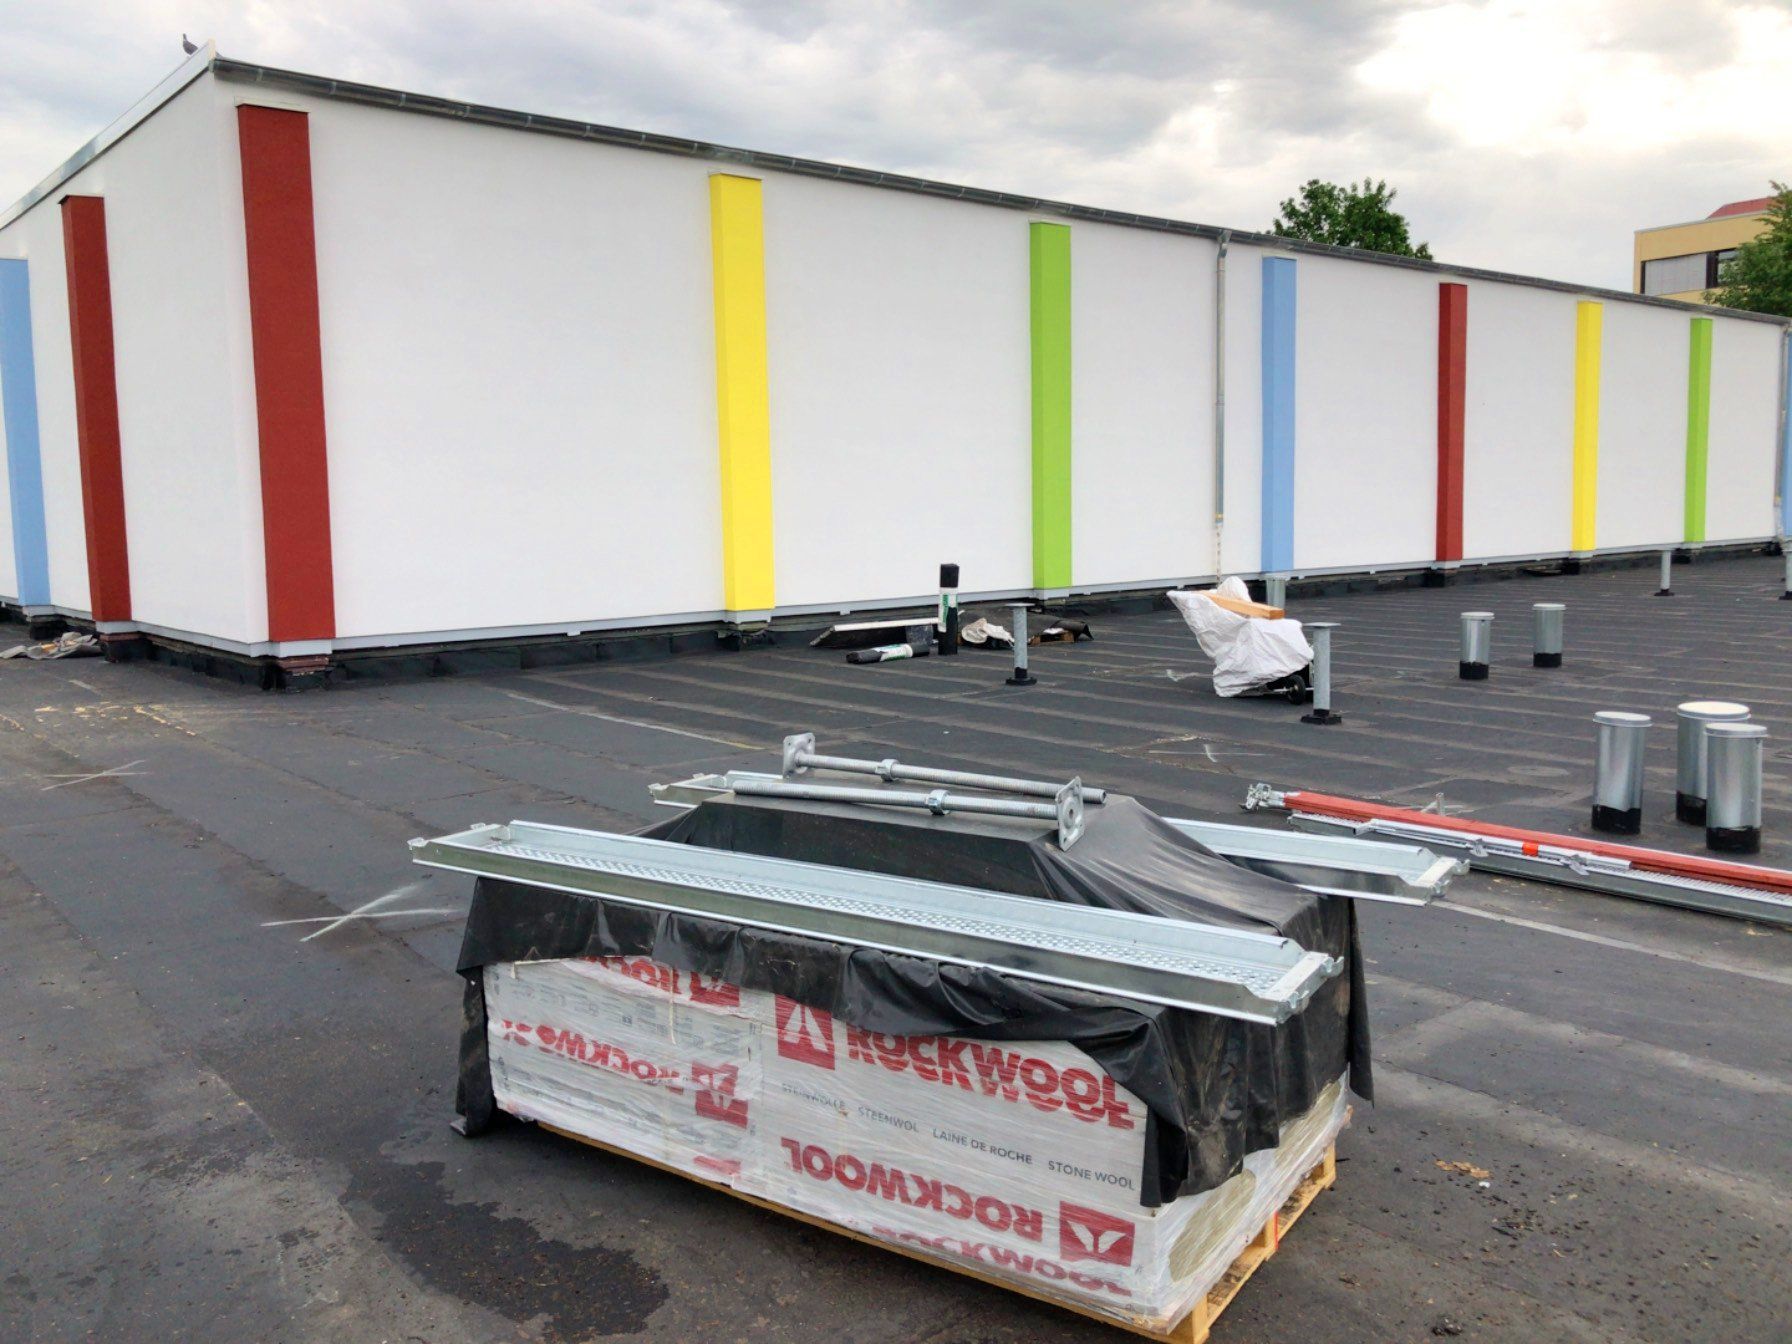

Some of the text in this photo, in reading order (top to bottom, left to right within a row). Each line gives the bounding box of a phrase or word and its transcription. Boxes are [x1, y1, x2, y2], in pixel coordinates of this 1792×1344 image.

[847, 1025, 1129, 1113] ROCKWOOL
[781, 1137, 1043, 1242] ROCKWOOL
[933, 1128, 967, 1146] LAINE
[971, 1139, 986, 1151] DE
[989, 1146, 1032, 1164] ROCHE
[1048, 1160, 1091, 1180] STONE
[1094, 1171, 1135, 1191] WOOL
